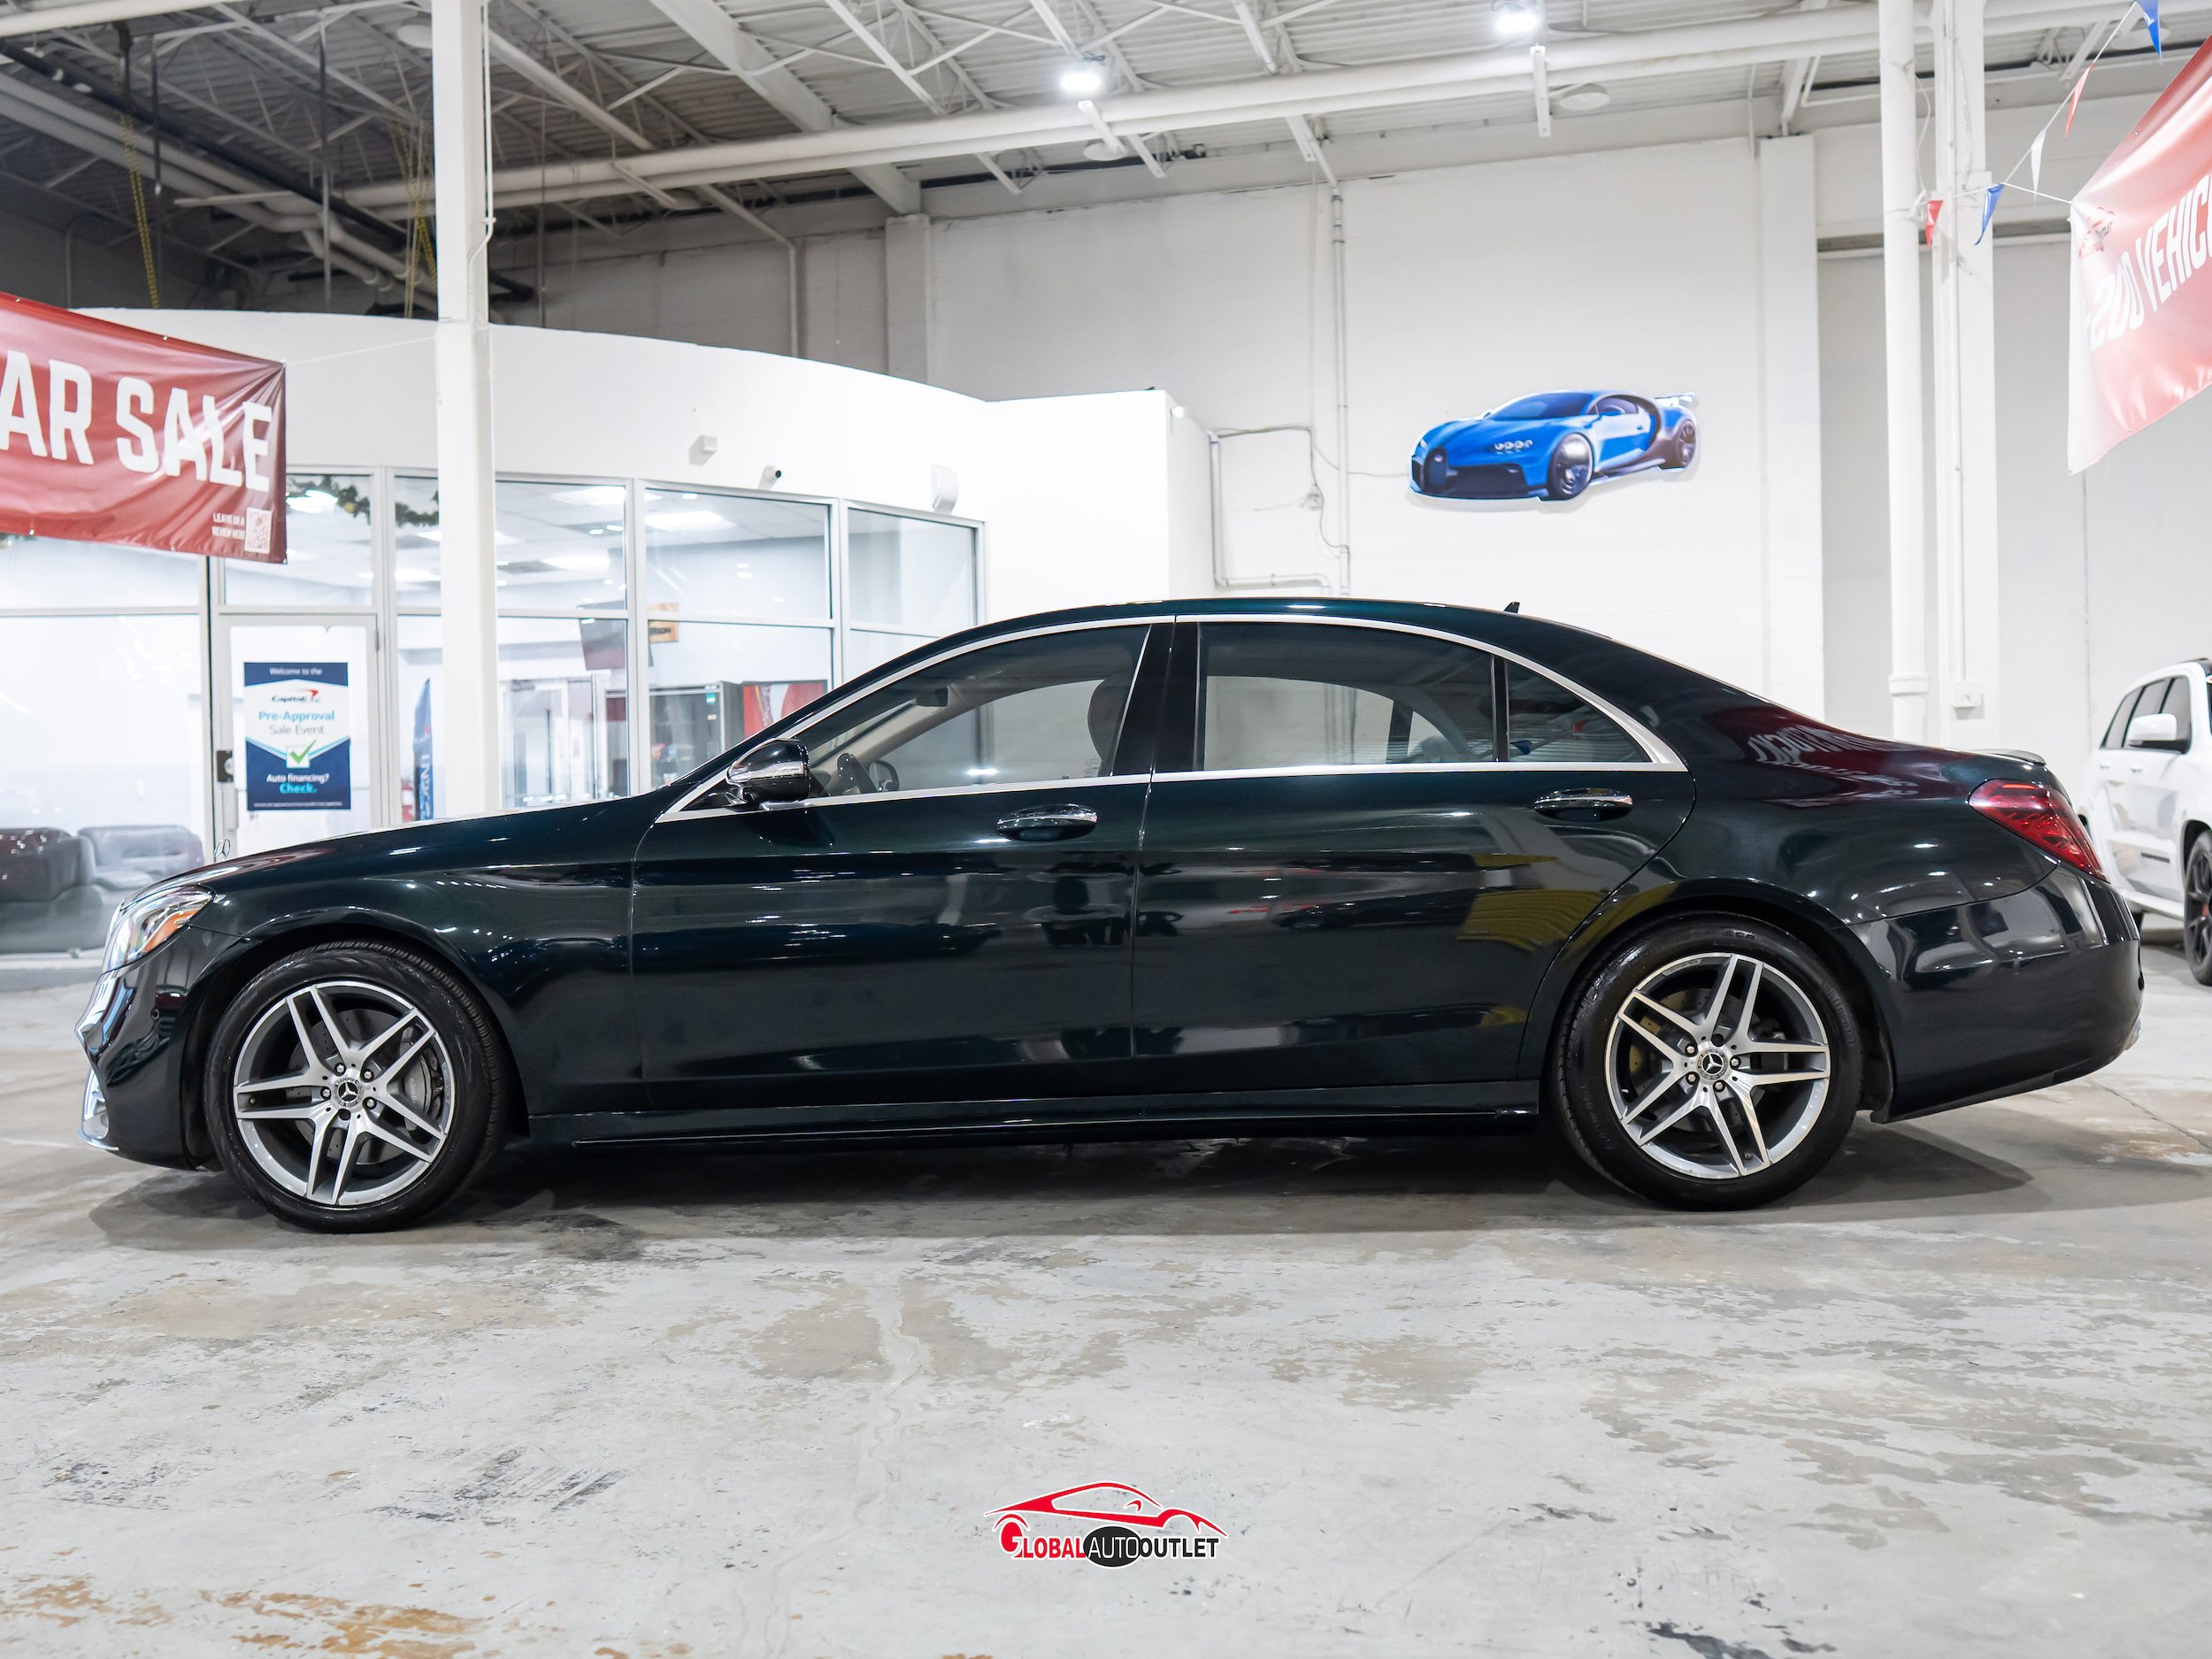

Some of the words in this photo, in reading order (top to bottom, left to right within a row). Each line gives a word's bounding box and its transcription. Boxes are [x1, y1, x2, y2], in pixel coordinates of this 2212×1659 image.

[2135, 171, 2212, 312] VEHIC
[116, 376, 273, 493] SALE
[269, 667, 301, 676] Welcome
[310, 667, 322, 676] the
[258, 710, 334, 722] Pre-Approval
[269, 725, 291, 735] Sale
[295, 725, 325, 735] Event
[266, 773, 286, 783] Auto
[287, 772, 330, 785] financing?
[279, 782, 317, 794] Check.
